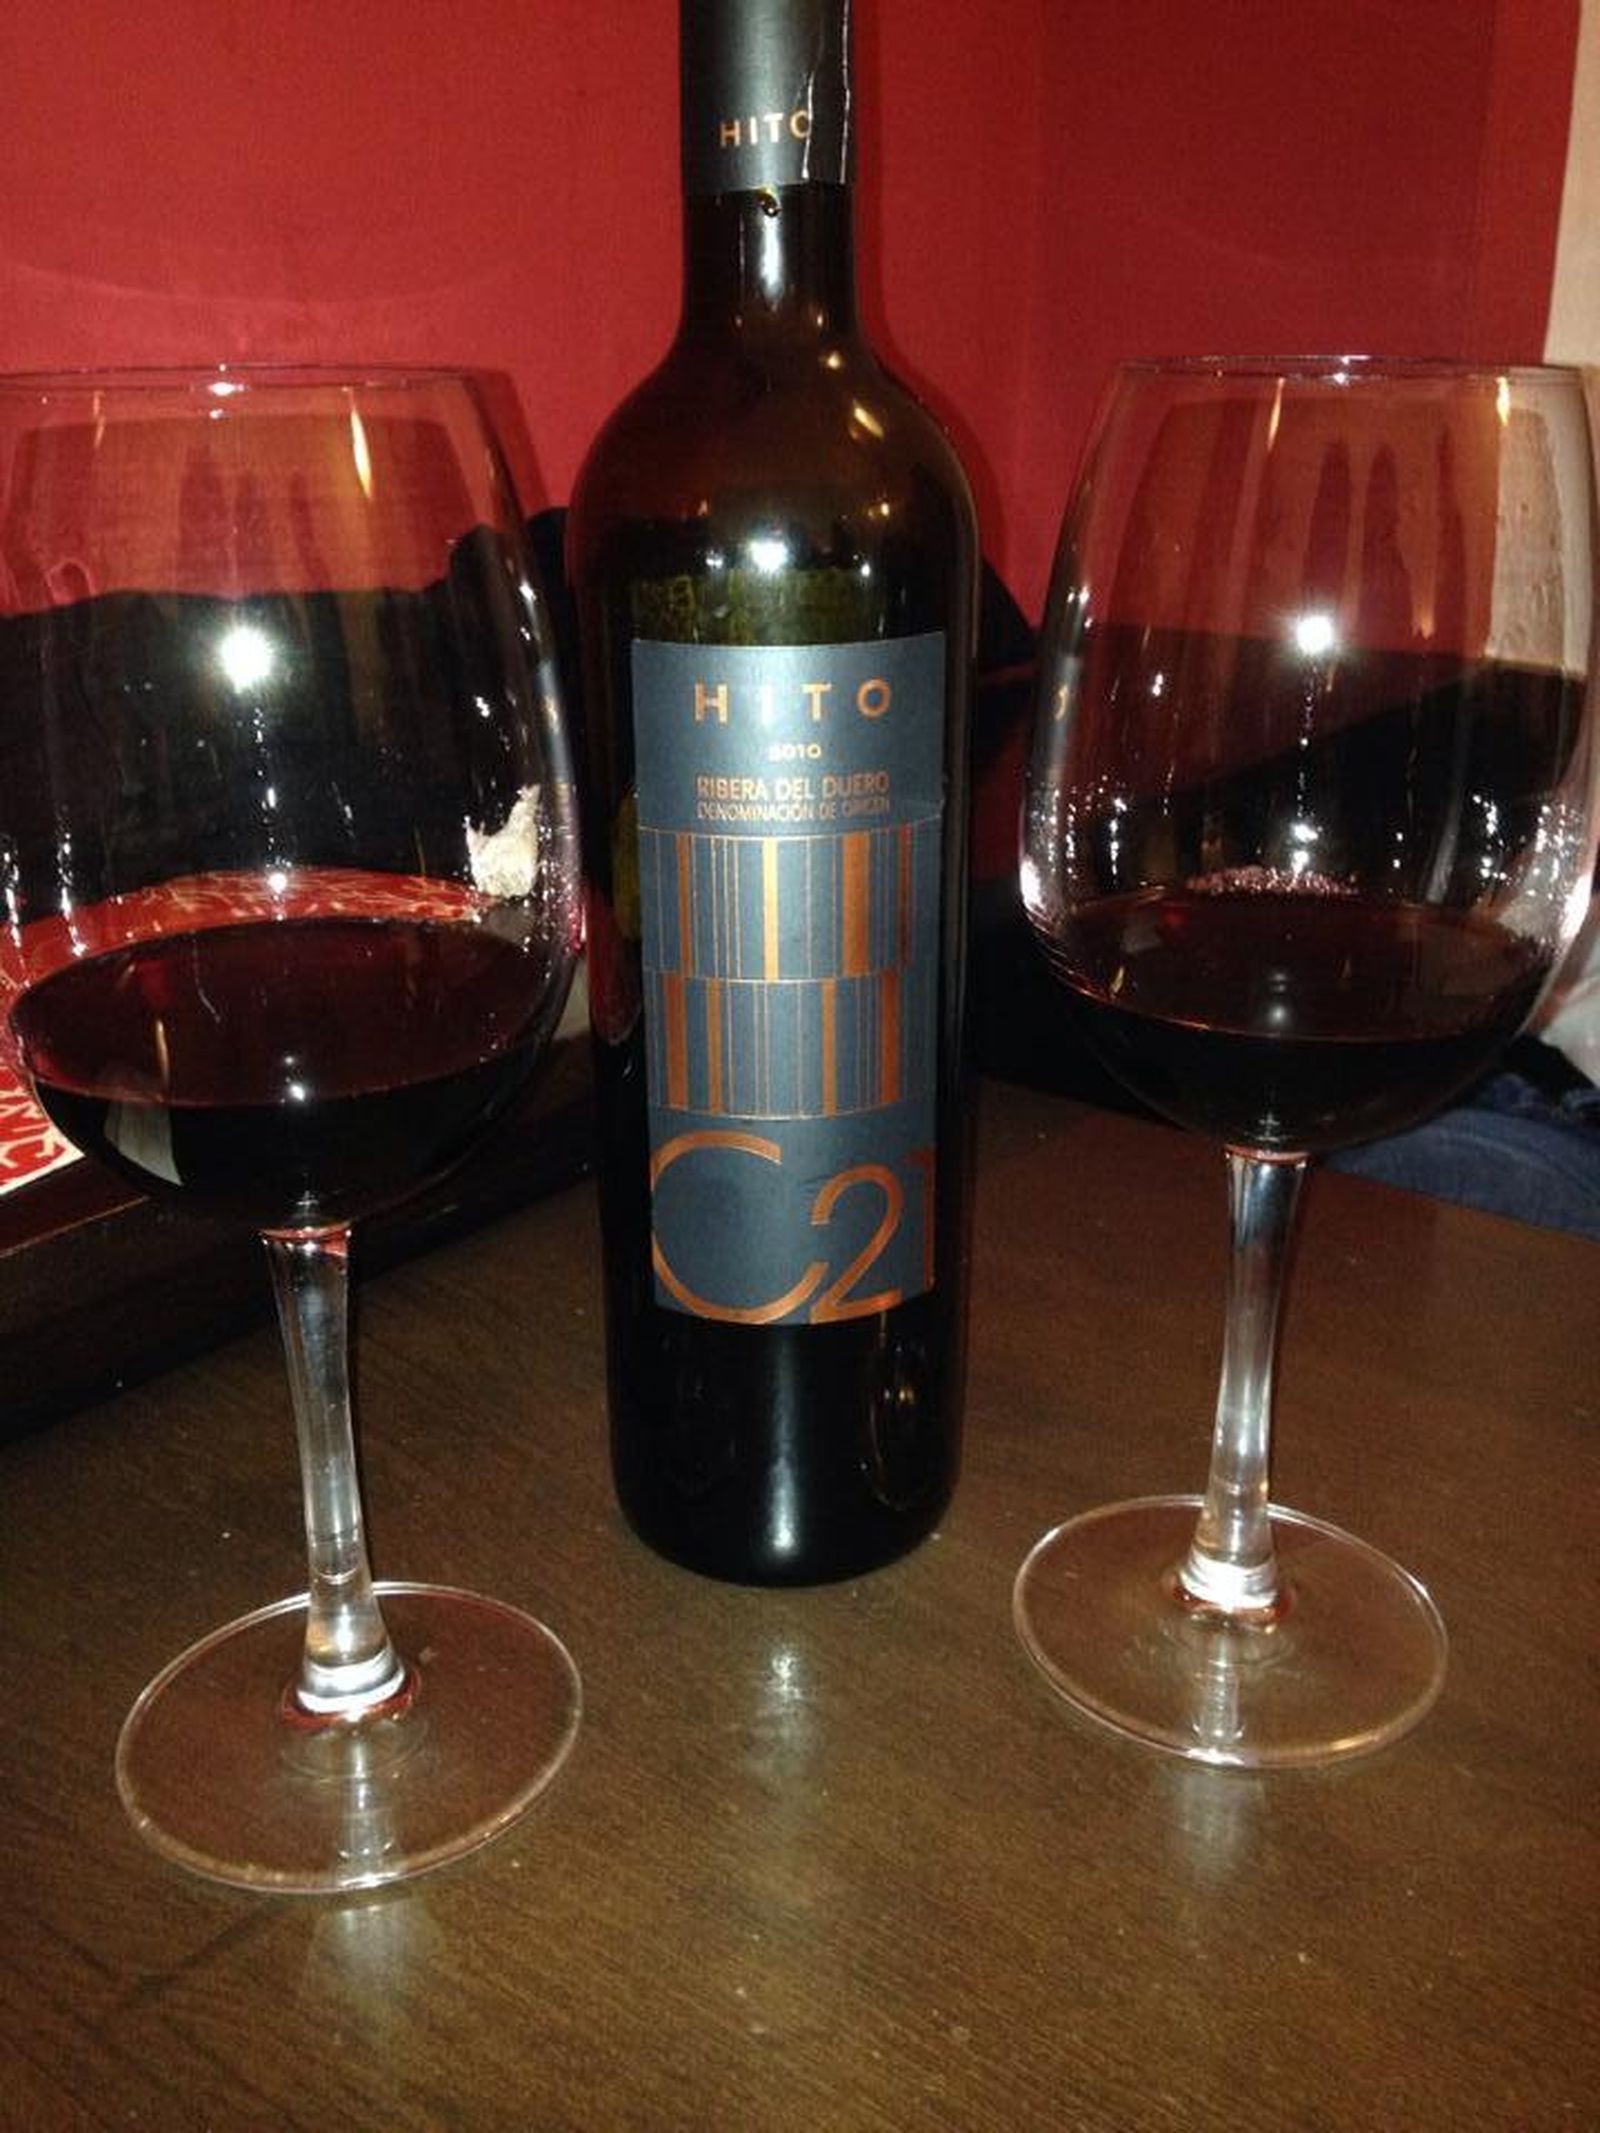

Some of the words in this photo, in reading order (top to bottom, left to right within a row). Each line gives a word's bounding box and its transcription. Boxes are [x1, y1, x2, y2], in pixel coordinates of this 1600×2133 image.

[720, 109, 813, 147] HITO
[695, 676, 891, 723] HITO
[769, 743, 821, 761] 2010
[697, 775, 768, 800] RIBERA
[775, 776, 814, 800] DEL
[822, 771, 889, 799] DUERO
[819, 801, 837, 820] DE
